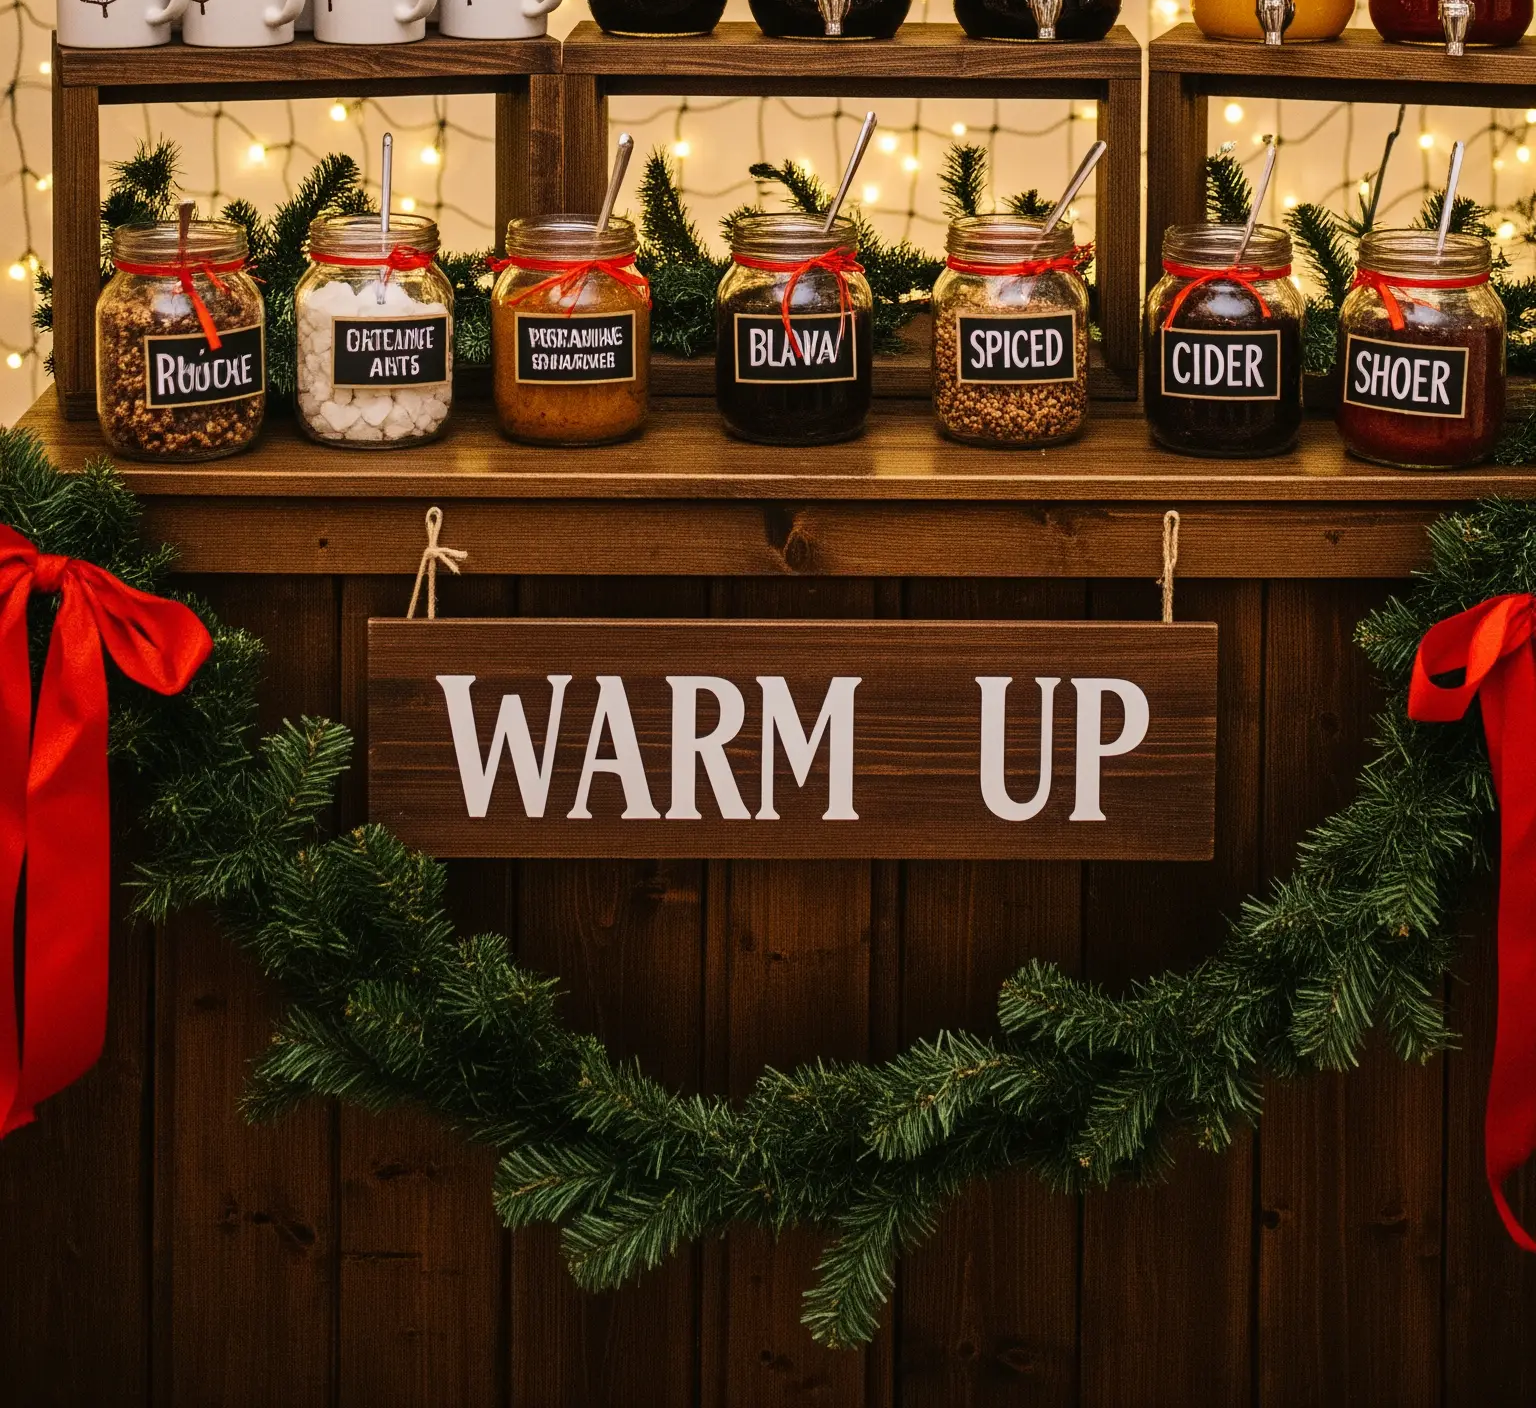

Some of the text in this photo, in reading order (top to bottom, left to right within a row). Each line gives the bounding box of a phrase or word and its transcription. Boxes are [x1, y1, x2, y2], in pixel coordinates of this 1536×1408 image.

[969, 329, 1063, 369] SPICED
[1172, 342, 1265, 388] CIDER
[1354, 350, 1451, 406] SHOER
[435, 674, 1151, 822] WARM UP
